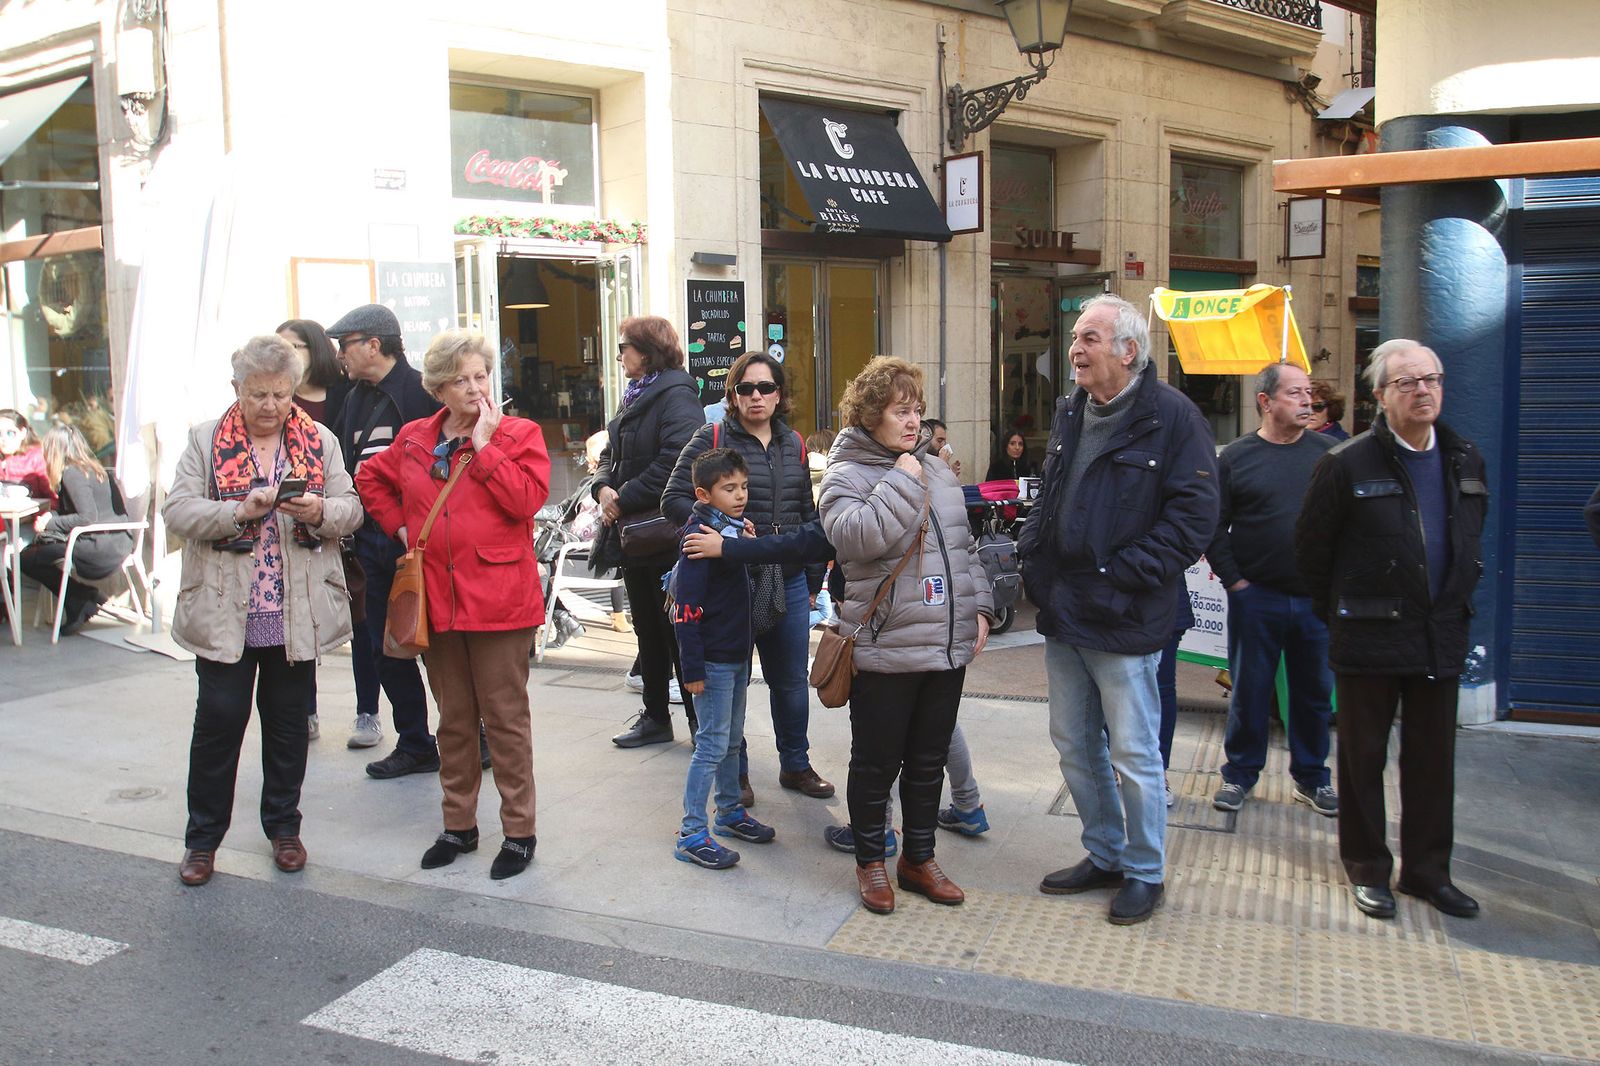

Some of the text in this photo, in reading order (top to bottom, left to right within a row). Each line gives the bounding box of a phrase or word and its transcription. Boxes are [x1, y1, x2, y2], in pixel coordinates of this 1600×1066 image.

[796, 160, 919, 189] LA CHUMBERA
[850, 187, 890, 205] CAFE
[819, 211, 860, 223] BLISS
[386, 272, 399, 287] LA
[693, 289, 739, 304] LA CHUMBERA
[1193, 297, 1242, 315] ONCE
[701, 309, 730, 320] BOCADILLOS
[707, 332, 726, 343] TARTAS
[690, 355, 715, 367] TOSTADAS
